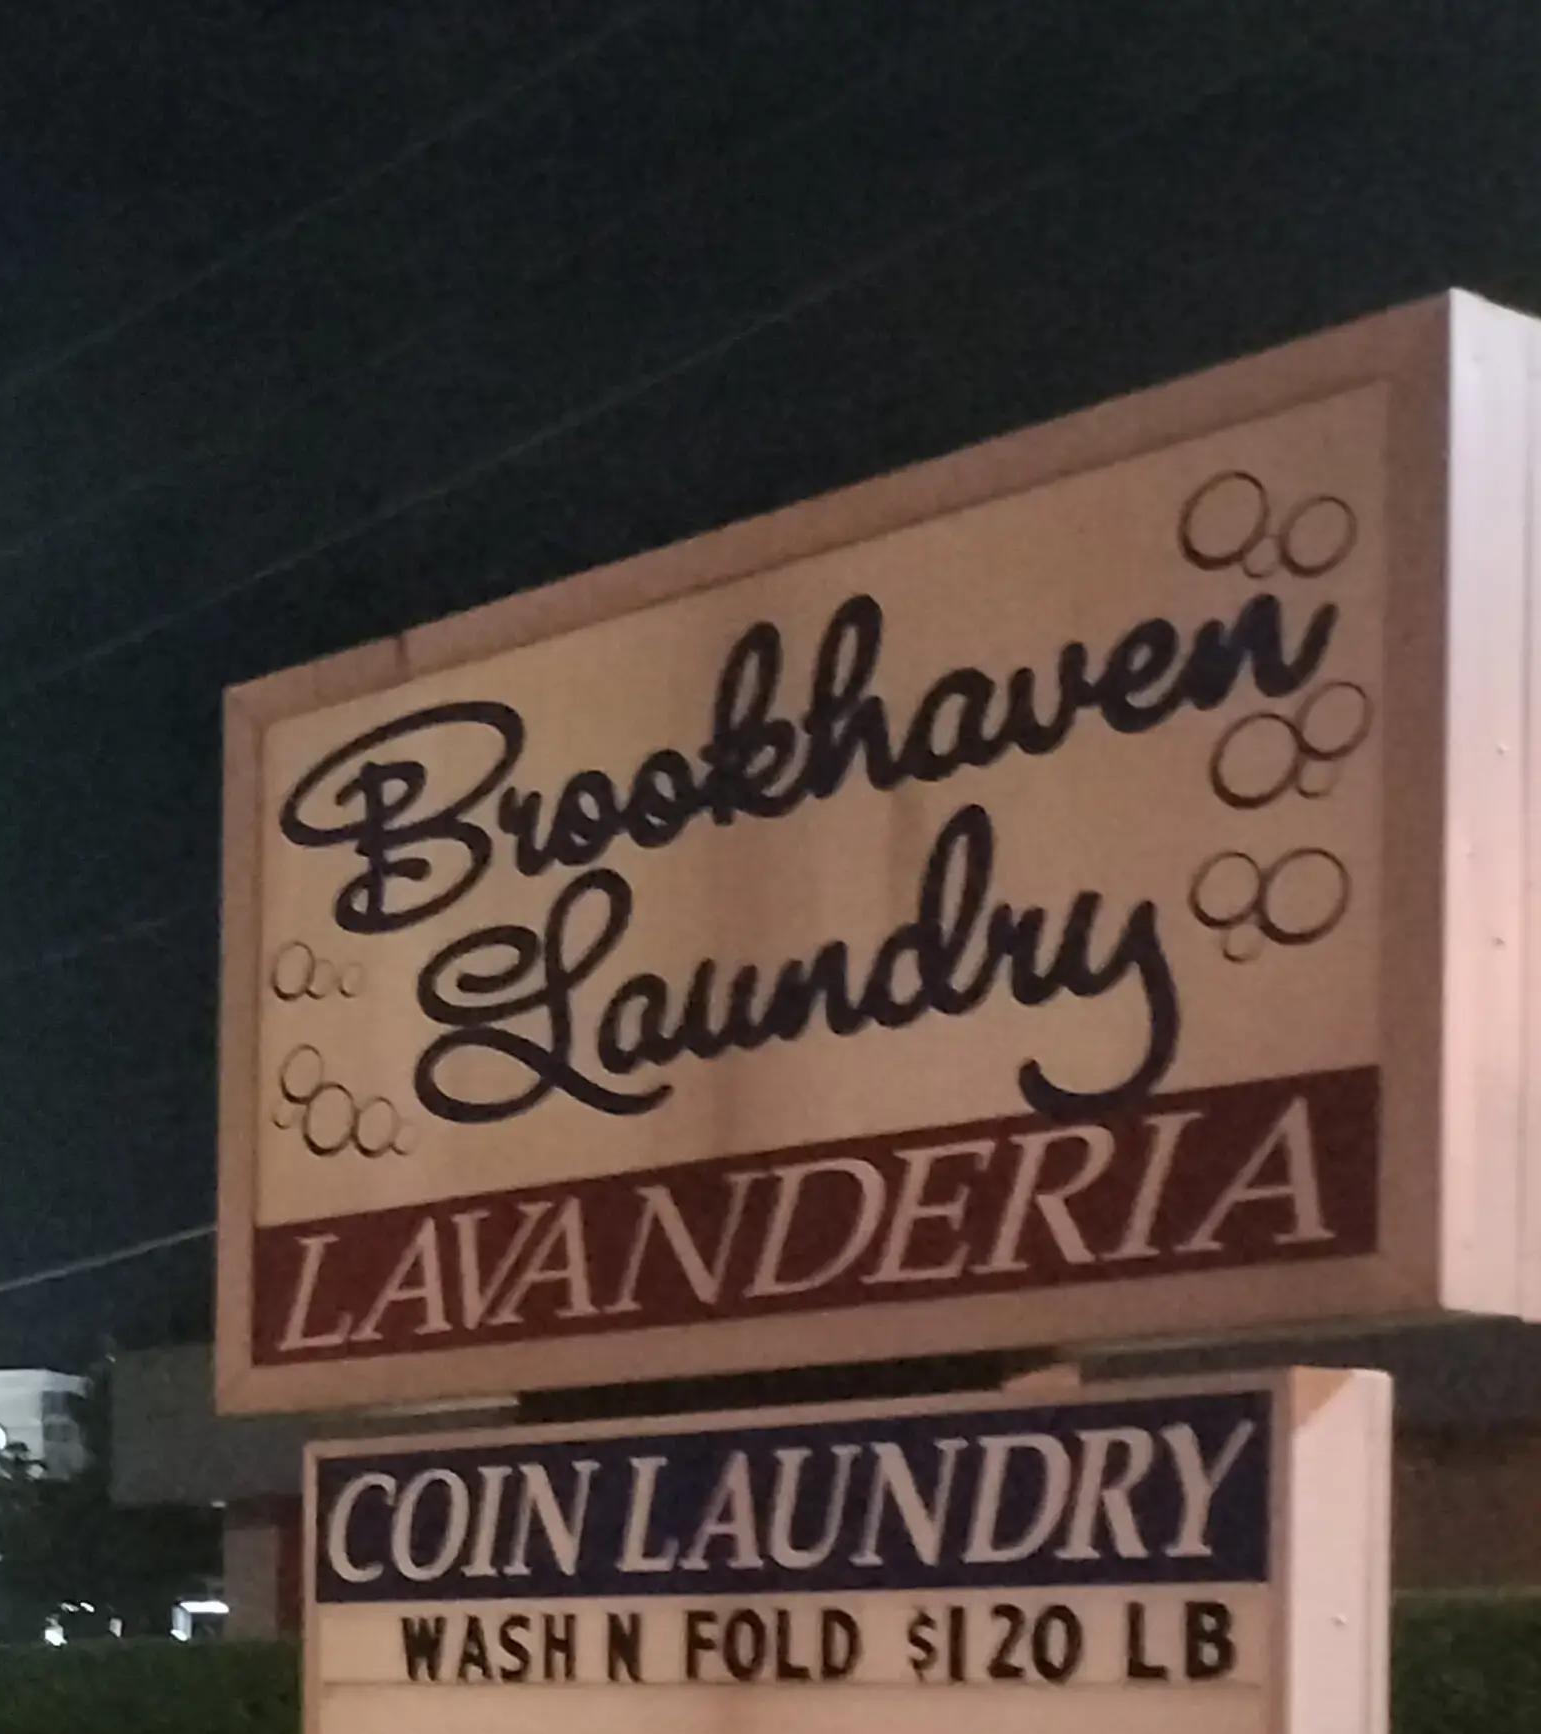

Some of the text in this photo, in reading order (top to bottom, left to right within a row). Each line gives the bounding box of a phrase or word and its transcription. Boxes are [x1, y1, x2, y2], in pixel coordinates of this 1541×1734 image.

[278, 594, 1337, 935] Brookhaven
[415, 804, 1180, 1123] Laundry
[279, 1097, 1337, 1352] LAVANDERIA
[327, 1420, 1255, 1583] COIN LAUNDRY
[401, 1608, 578, 1684] WASH
[607, 1610, 643, 1683] N
[685, 1608, 862, 1681] FOLD
[1126, 1600, 1237, 1681] LB
